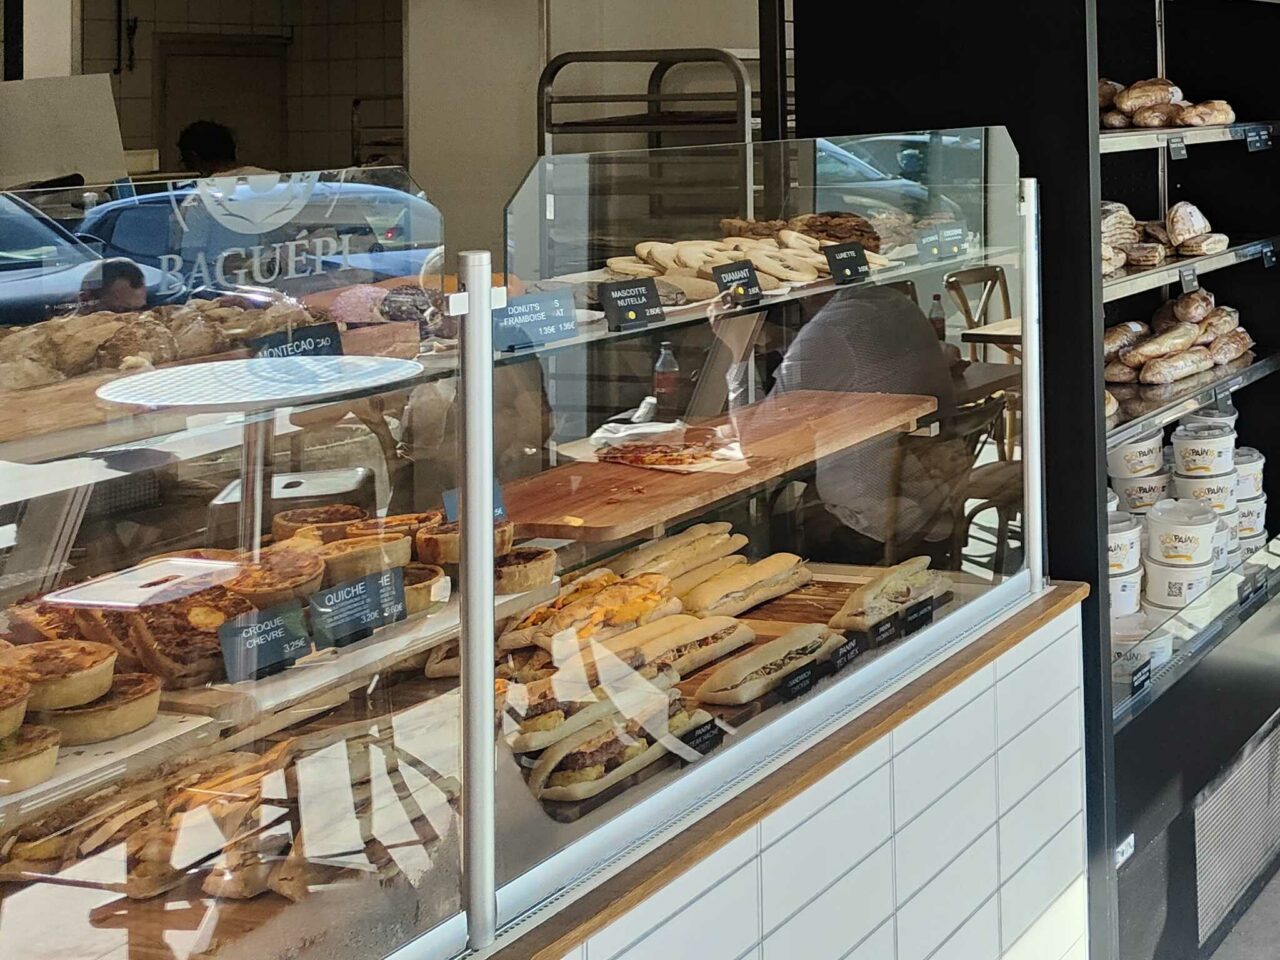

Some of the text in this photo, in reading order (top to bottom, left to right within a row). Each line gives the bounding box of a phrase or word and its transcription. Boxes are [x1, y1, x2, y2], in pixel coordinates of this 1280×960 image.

[157, 229, 353, 294] BAGUÉPI
[721, 268, 750, 283] DIAMANT
[611, 286, 648, 298] MASCOTTE
[617, 296, 647, 307] NUTELLA
[503, 311, 546, 326] FRAMBOISE
[324, 581, 367, 606] QUICHE
[243, 616, 284, 638] CROQUE
[246, 627, 286, 649] CHEVRE
